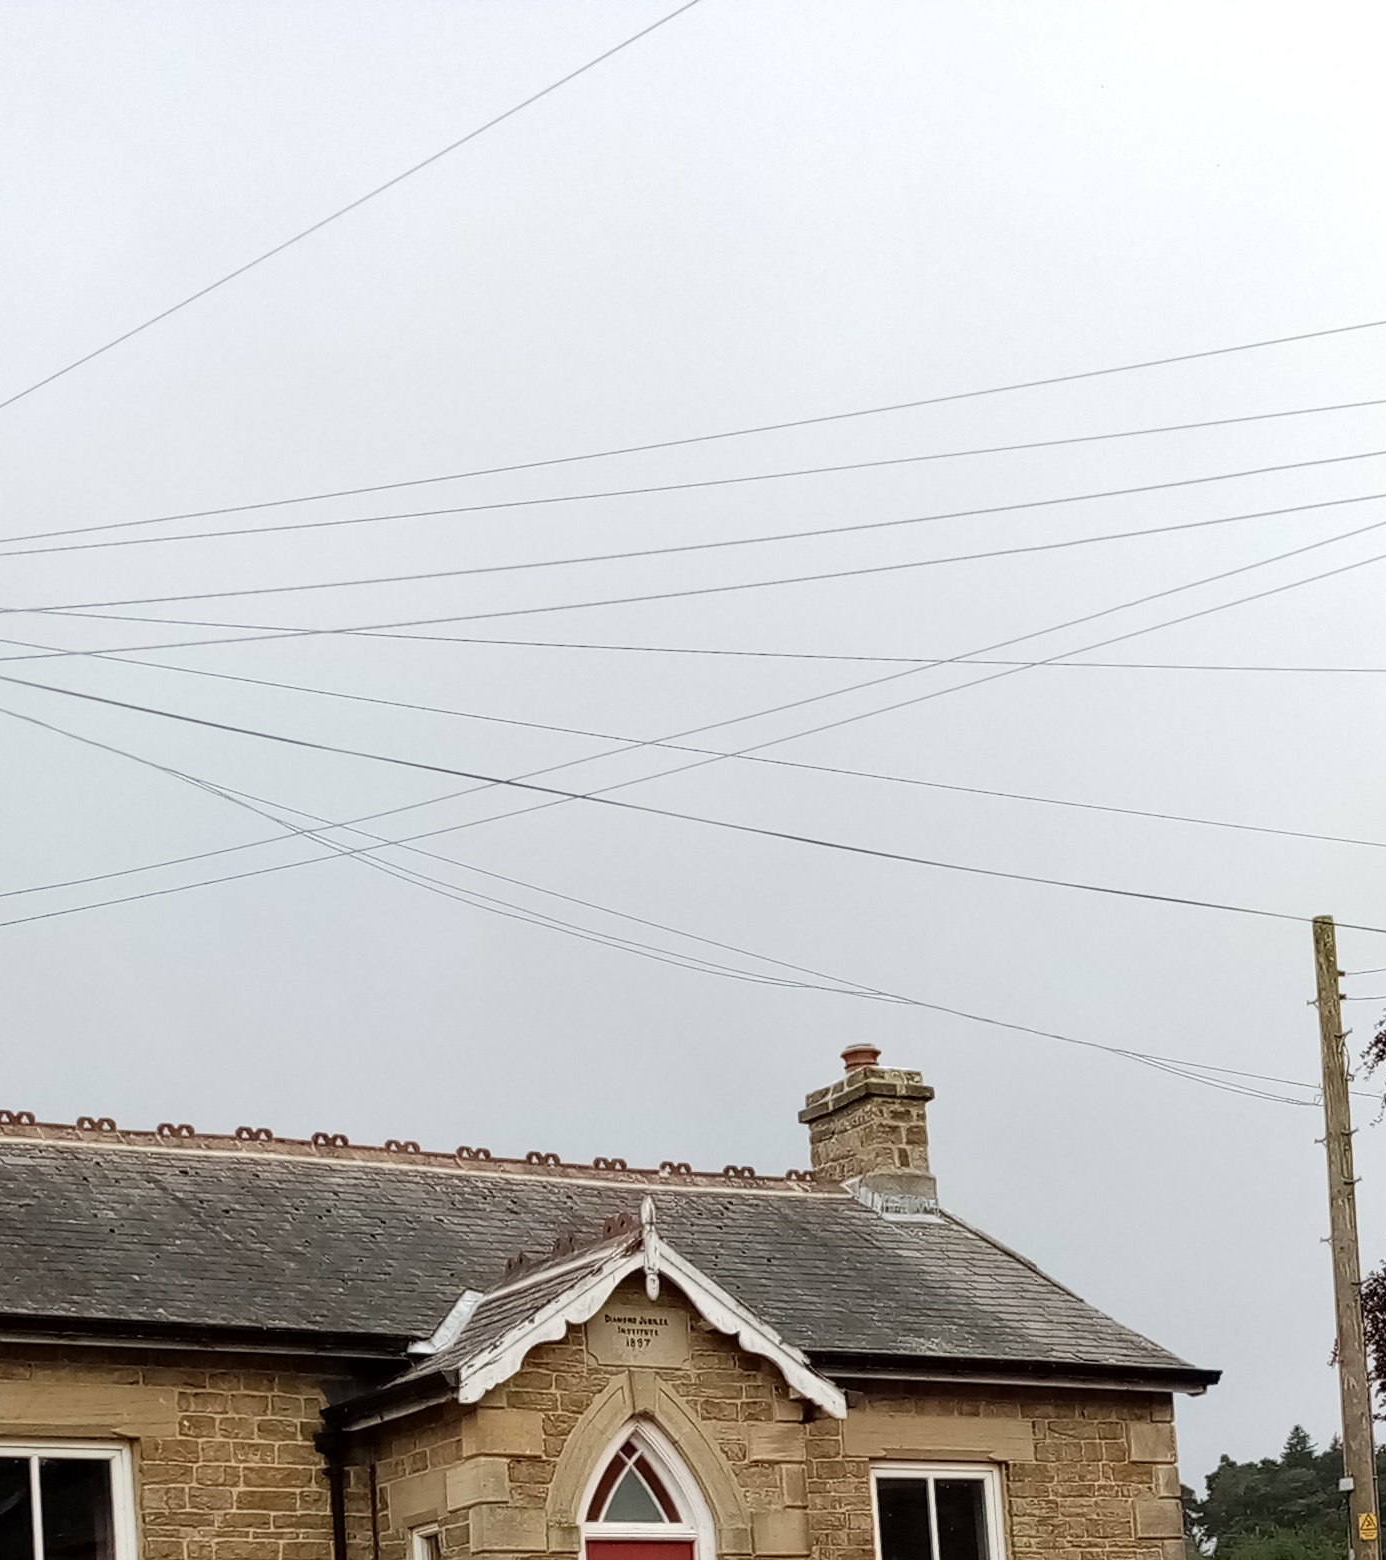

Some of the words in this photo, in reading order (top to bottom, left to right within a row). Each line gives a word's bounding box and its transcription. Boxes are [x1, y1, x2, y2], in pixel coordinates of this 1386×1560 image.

[604, 1313, 638, 1325] DIAMOND
[639, 1316, 670, 1327] JUBILEE
[617, 1325, 660, 1337] INSTITUTE
[625, 1336, 652, 1348] 1897
